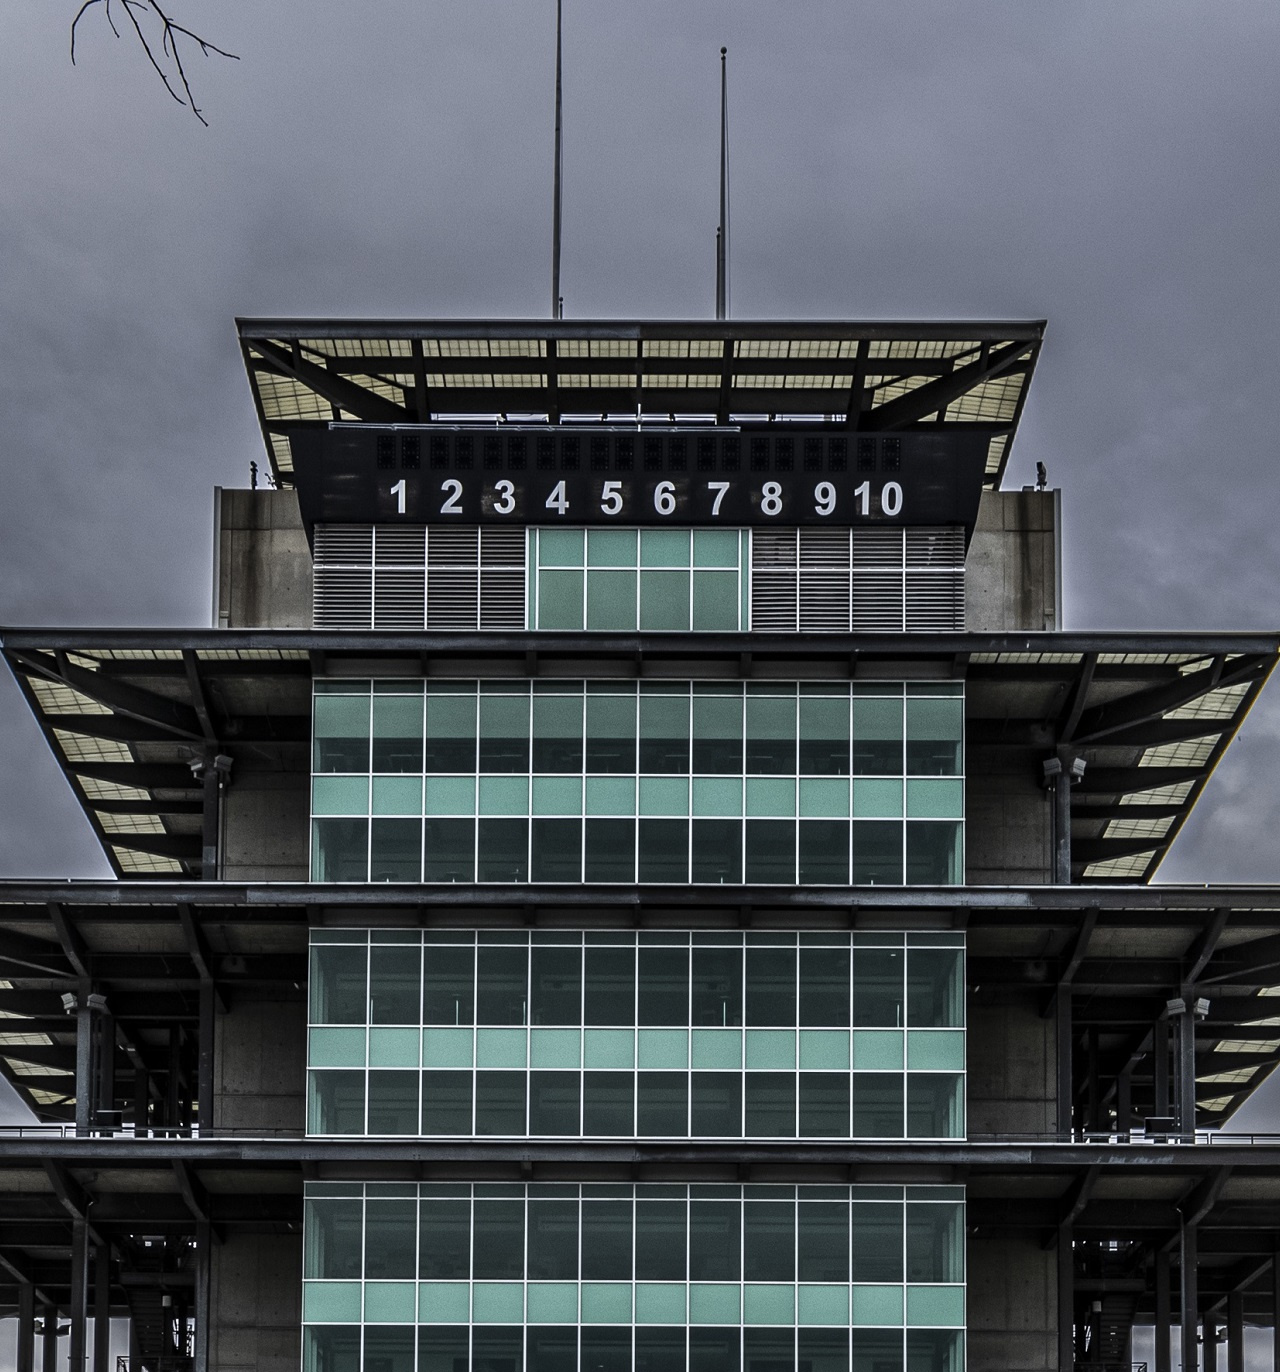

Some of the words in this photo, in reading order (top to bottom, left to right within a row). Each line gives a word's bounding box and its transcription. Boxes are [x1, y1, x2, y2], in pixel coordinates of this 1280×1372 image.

[390, 479, 406, 514] 1
[440, 479, 463, 514] 2
[493, 479, 516, 515] 3
[545, 480, 570, 515] 4
[601, 480, 624, 515] 5
[653, 480, 676, 515] 6
[707, 481, 730, 516] 7
[760, 481, 783, 516] 8
[814, 481, 837, 516] 9
[853, 480, 903, 516] 10
